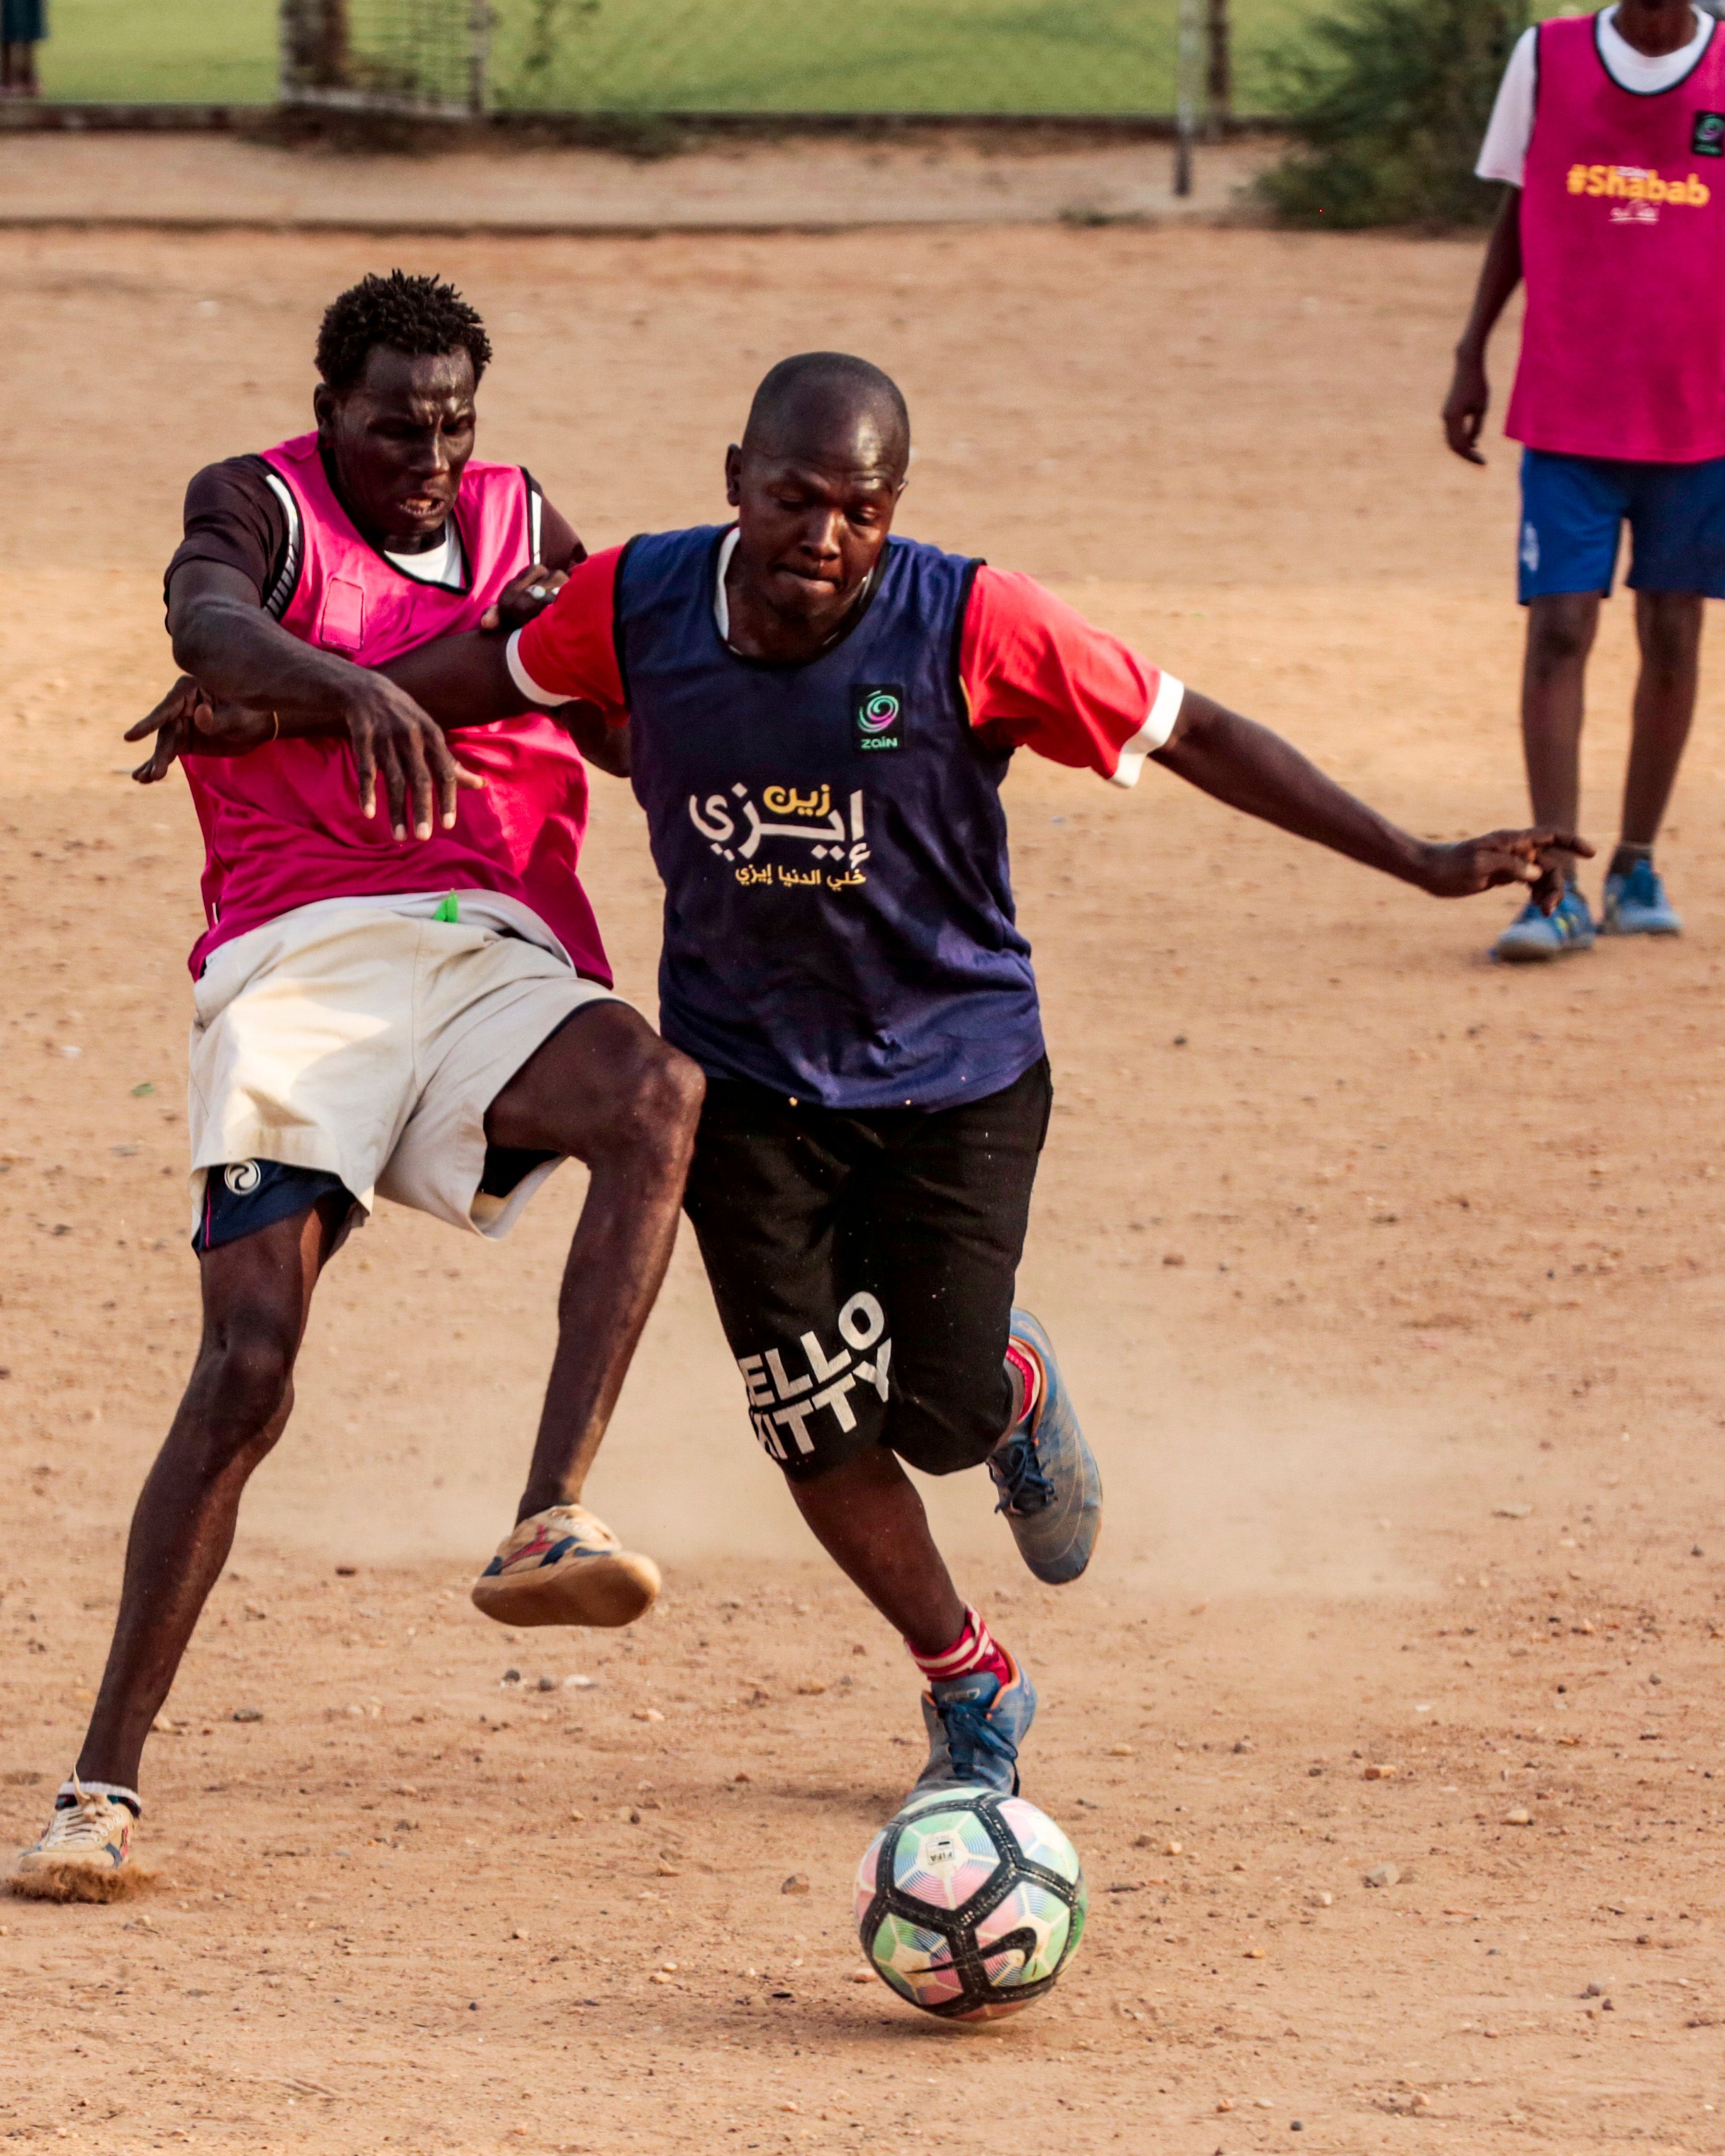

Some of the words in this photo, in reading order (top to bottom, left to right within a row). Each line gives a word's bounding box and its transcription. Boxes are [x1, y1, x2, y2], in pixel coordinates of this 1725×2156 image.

[1566, 164, 1710, 207] #Shabab
[763, 784, 831, 817] زين
[735, 863, 774, 886] إيزي
[777, 865, 821, 887] الدنيا
[826, 868, 867, 892] خلي
[738, 1291, 885, 1408] ELLO
